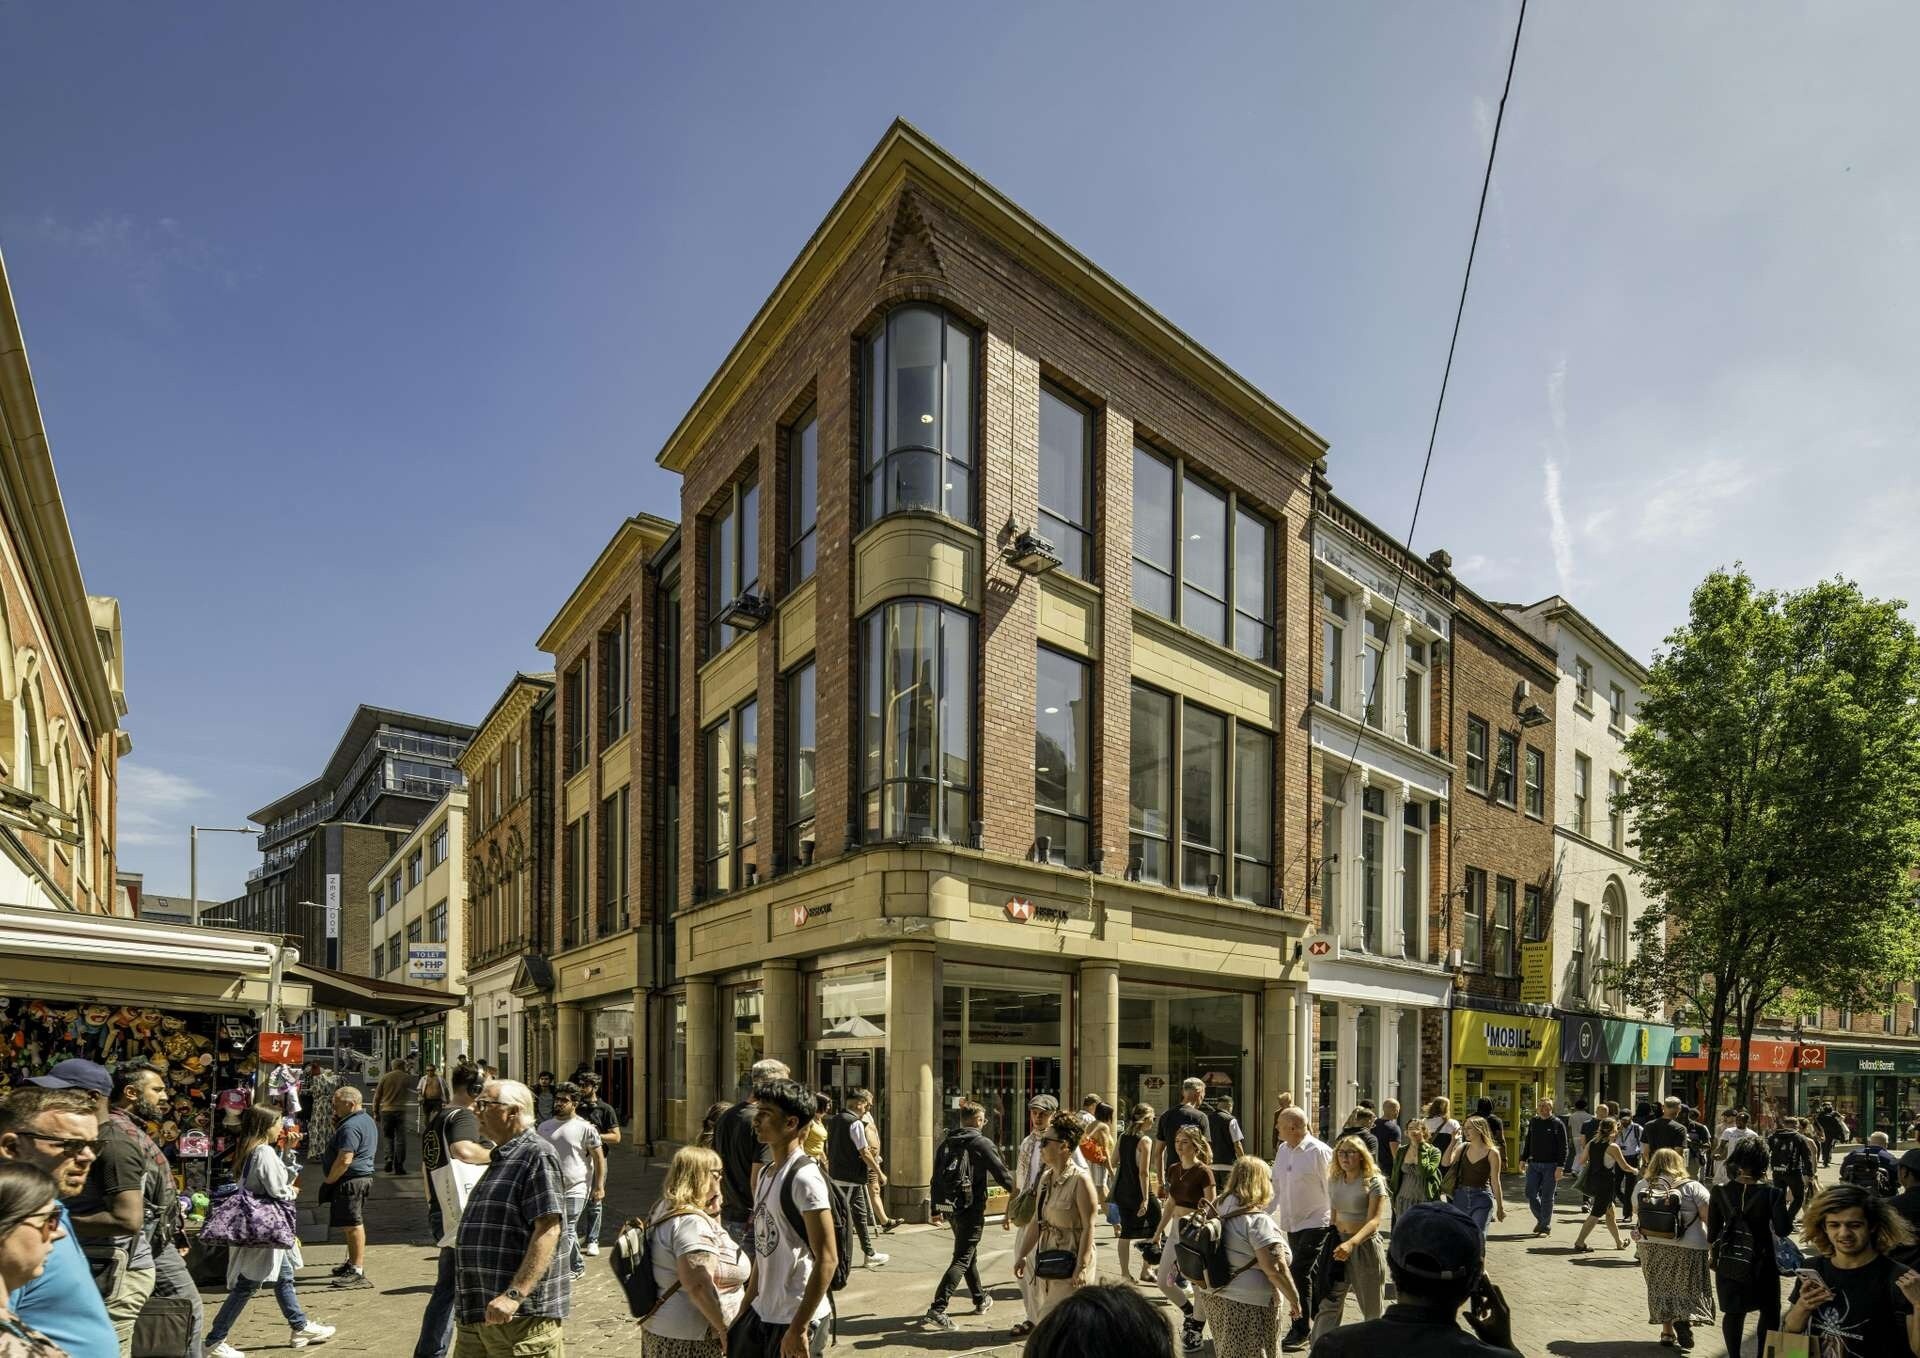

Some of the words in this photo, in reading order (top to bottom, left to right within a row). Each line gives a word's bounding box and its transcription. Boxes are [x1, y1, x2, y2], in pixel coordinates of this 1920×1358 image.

[425, 960, 443, 969] FHP
[1582, 1033, 1591, 1048] BT
[271, 1040, 291, 1058] £7
